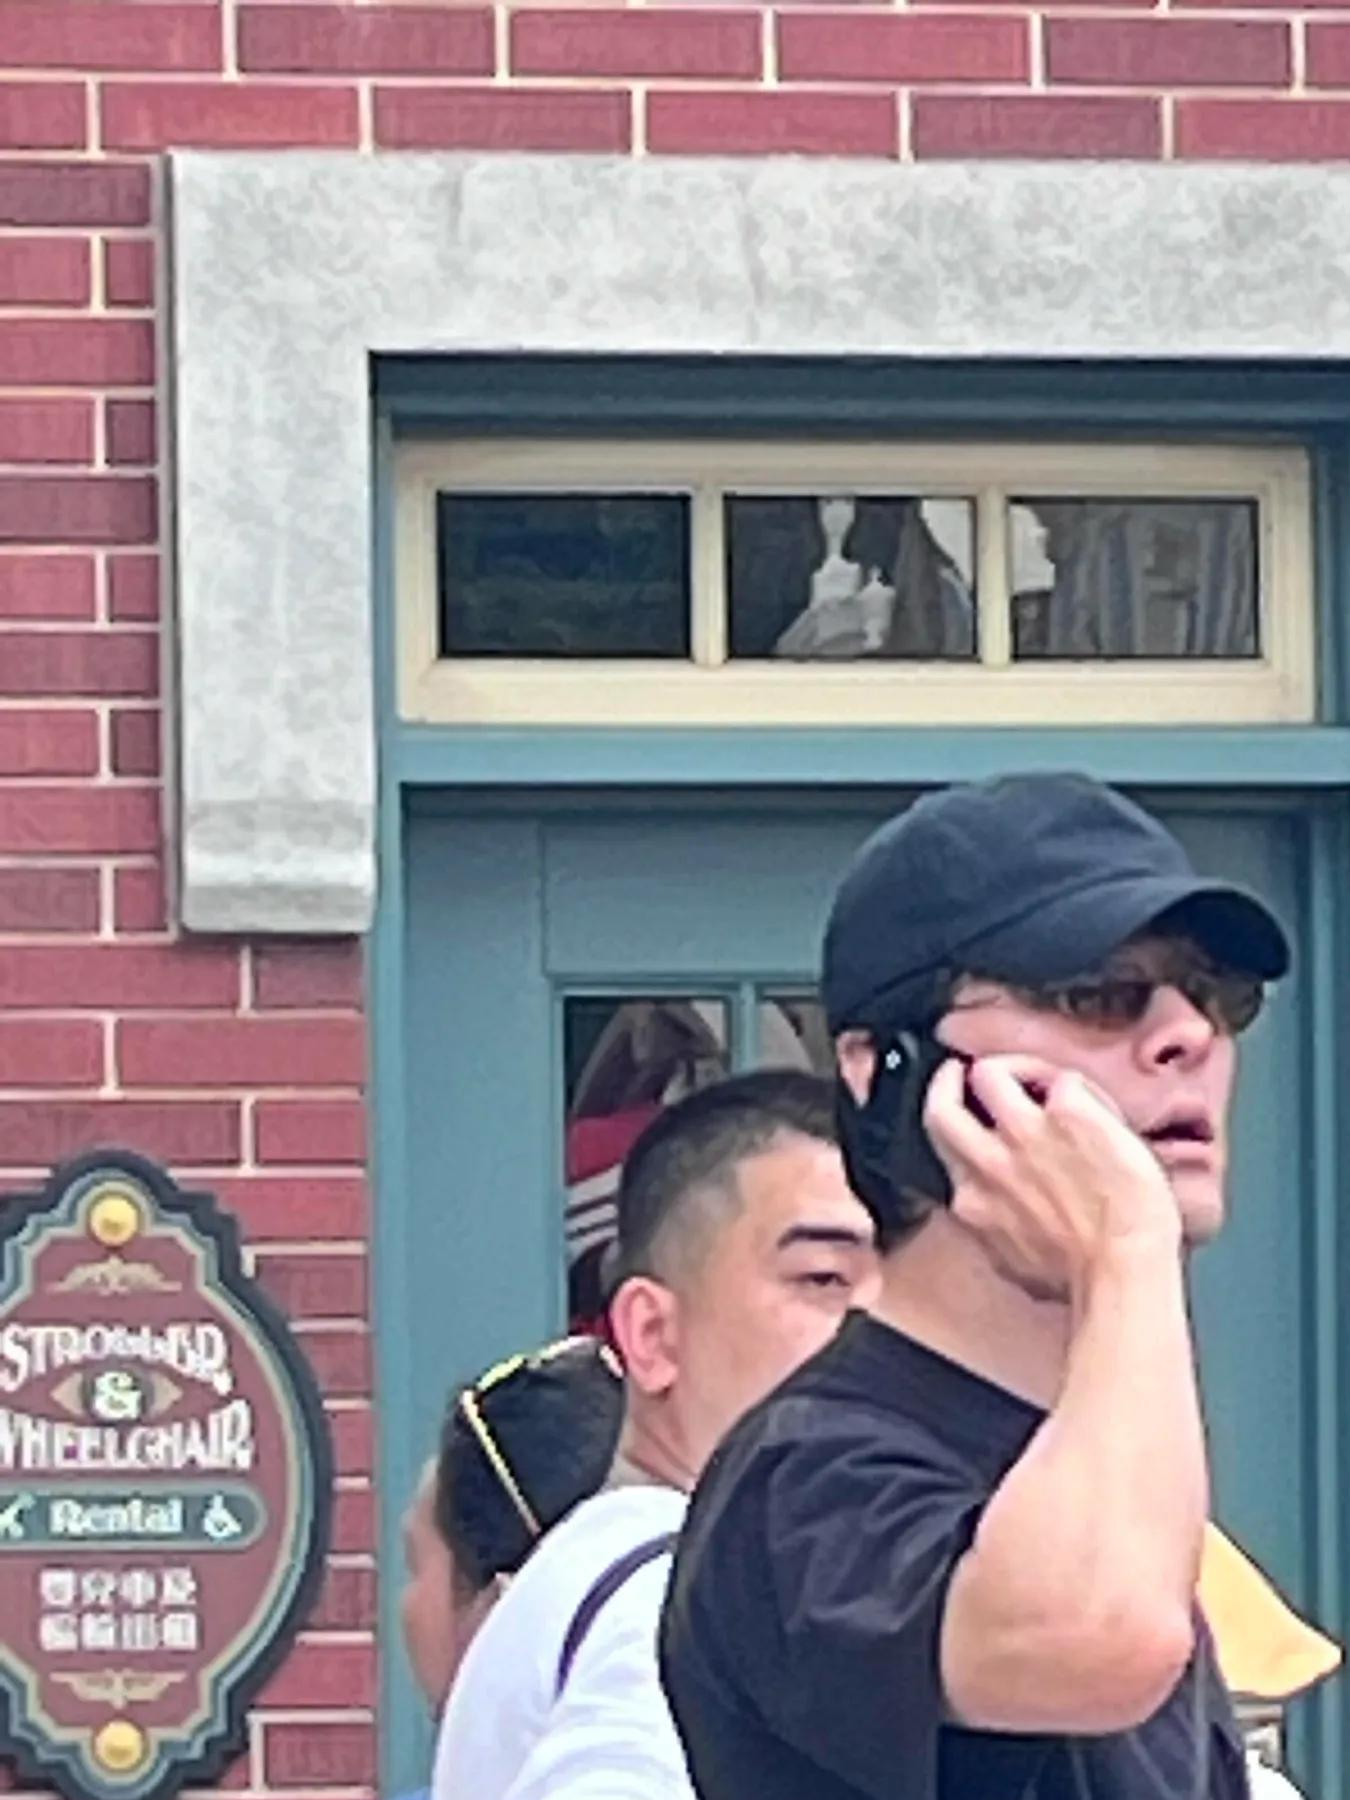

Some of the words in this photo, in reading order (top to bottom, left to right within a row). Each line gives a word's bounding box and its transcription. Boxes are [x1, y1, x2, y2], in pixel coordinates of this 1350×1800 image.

[0, 1323, 233, 1393] STROLLER
[93, 1370, 142, 1420] &
[50, 1498, 182, 1534] Rental
